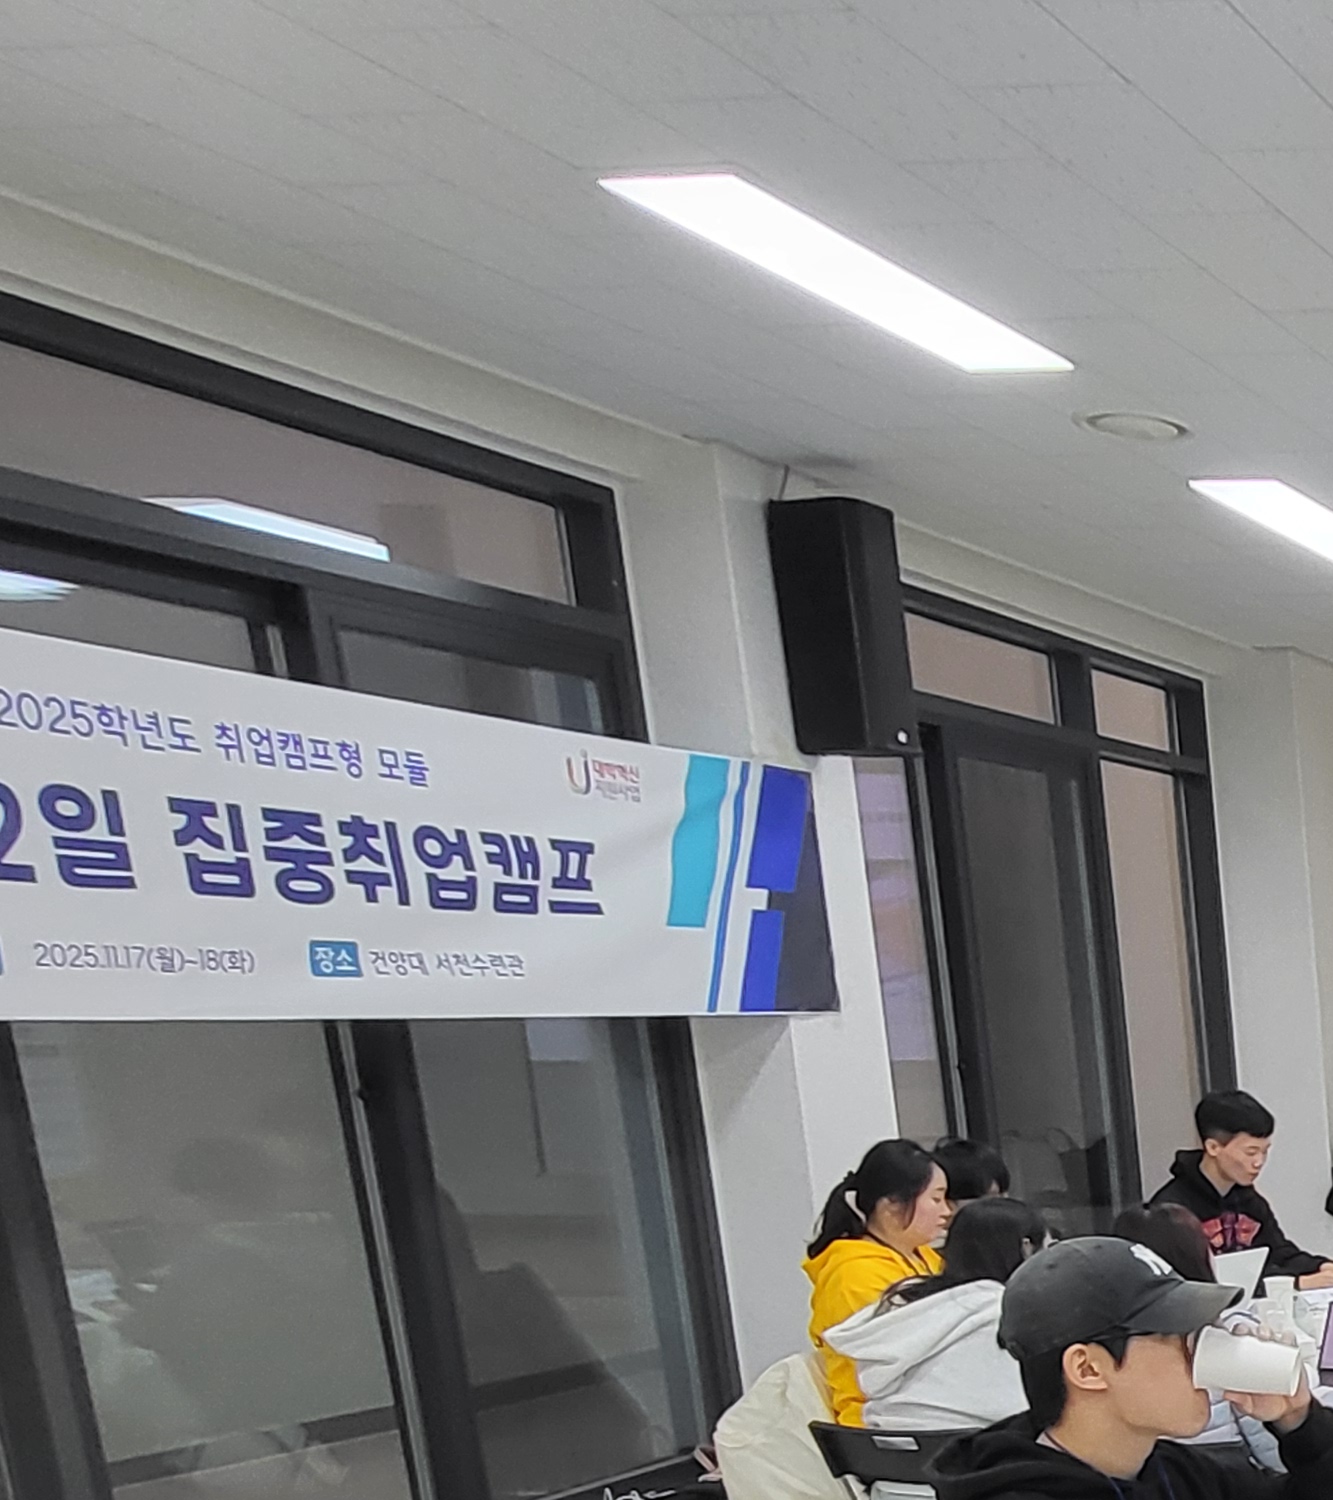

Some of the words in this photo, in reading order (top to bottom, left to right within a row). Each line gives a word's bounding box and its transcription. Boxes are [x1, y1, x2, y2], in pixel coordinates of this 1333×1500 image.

[0, 688, 202, 754] 2025학년도
[213, 720, 364, 779] 취업캠프형
[377, 747, 431, 788] 모듈
[166, 795, 605, 915] 집중취업캠프
[313, 946, 358, 974] 장소
[370, 947, 430, 977] 건양대
